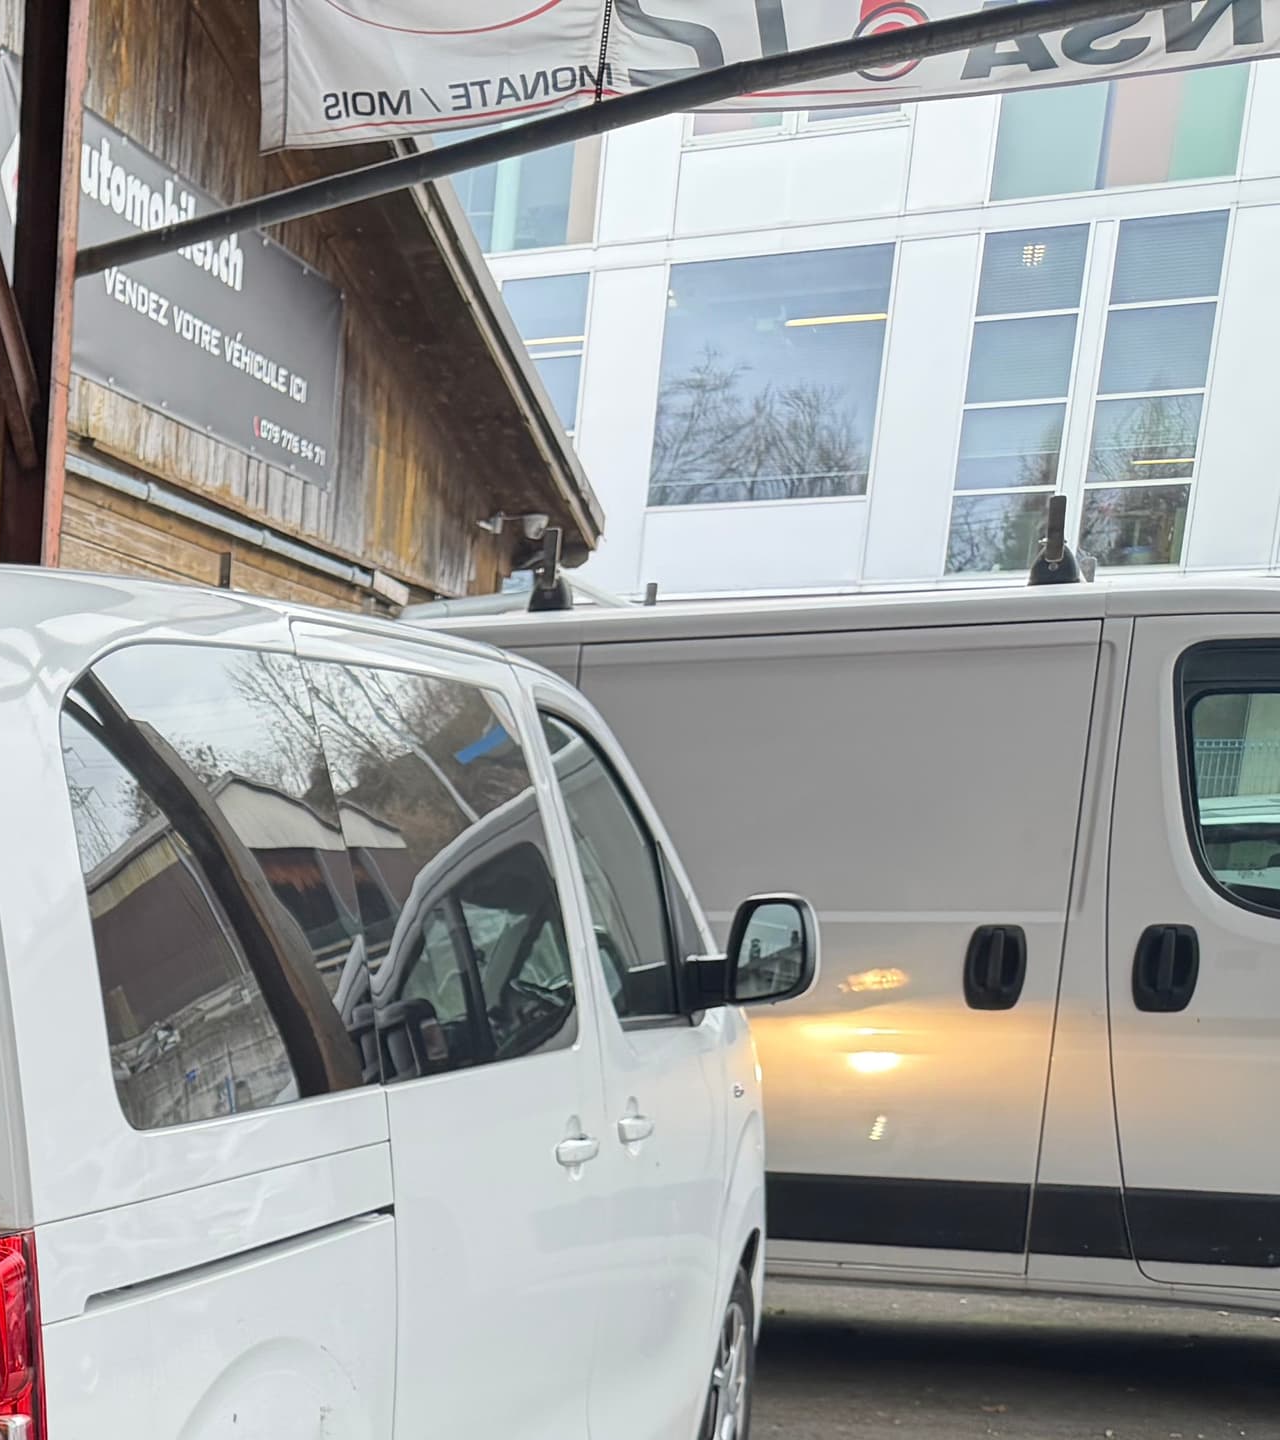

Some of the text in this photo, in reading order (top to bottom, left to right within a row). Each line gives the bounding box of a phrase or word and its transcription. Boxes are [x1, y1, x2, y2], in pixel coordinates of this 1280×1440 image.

[104, 266, 307, 403] VENDEZ VOTRE VÉHICULE ICI
[260, 418, 281, 444] 079
